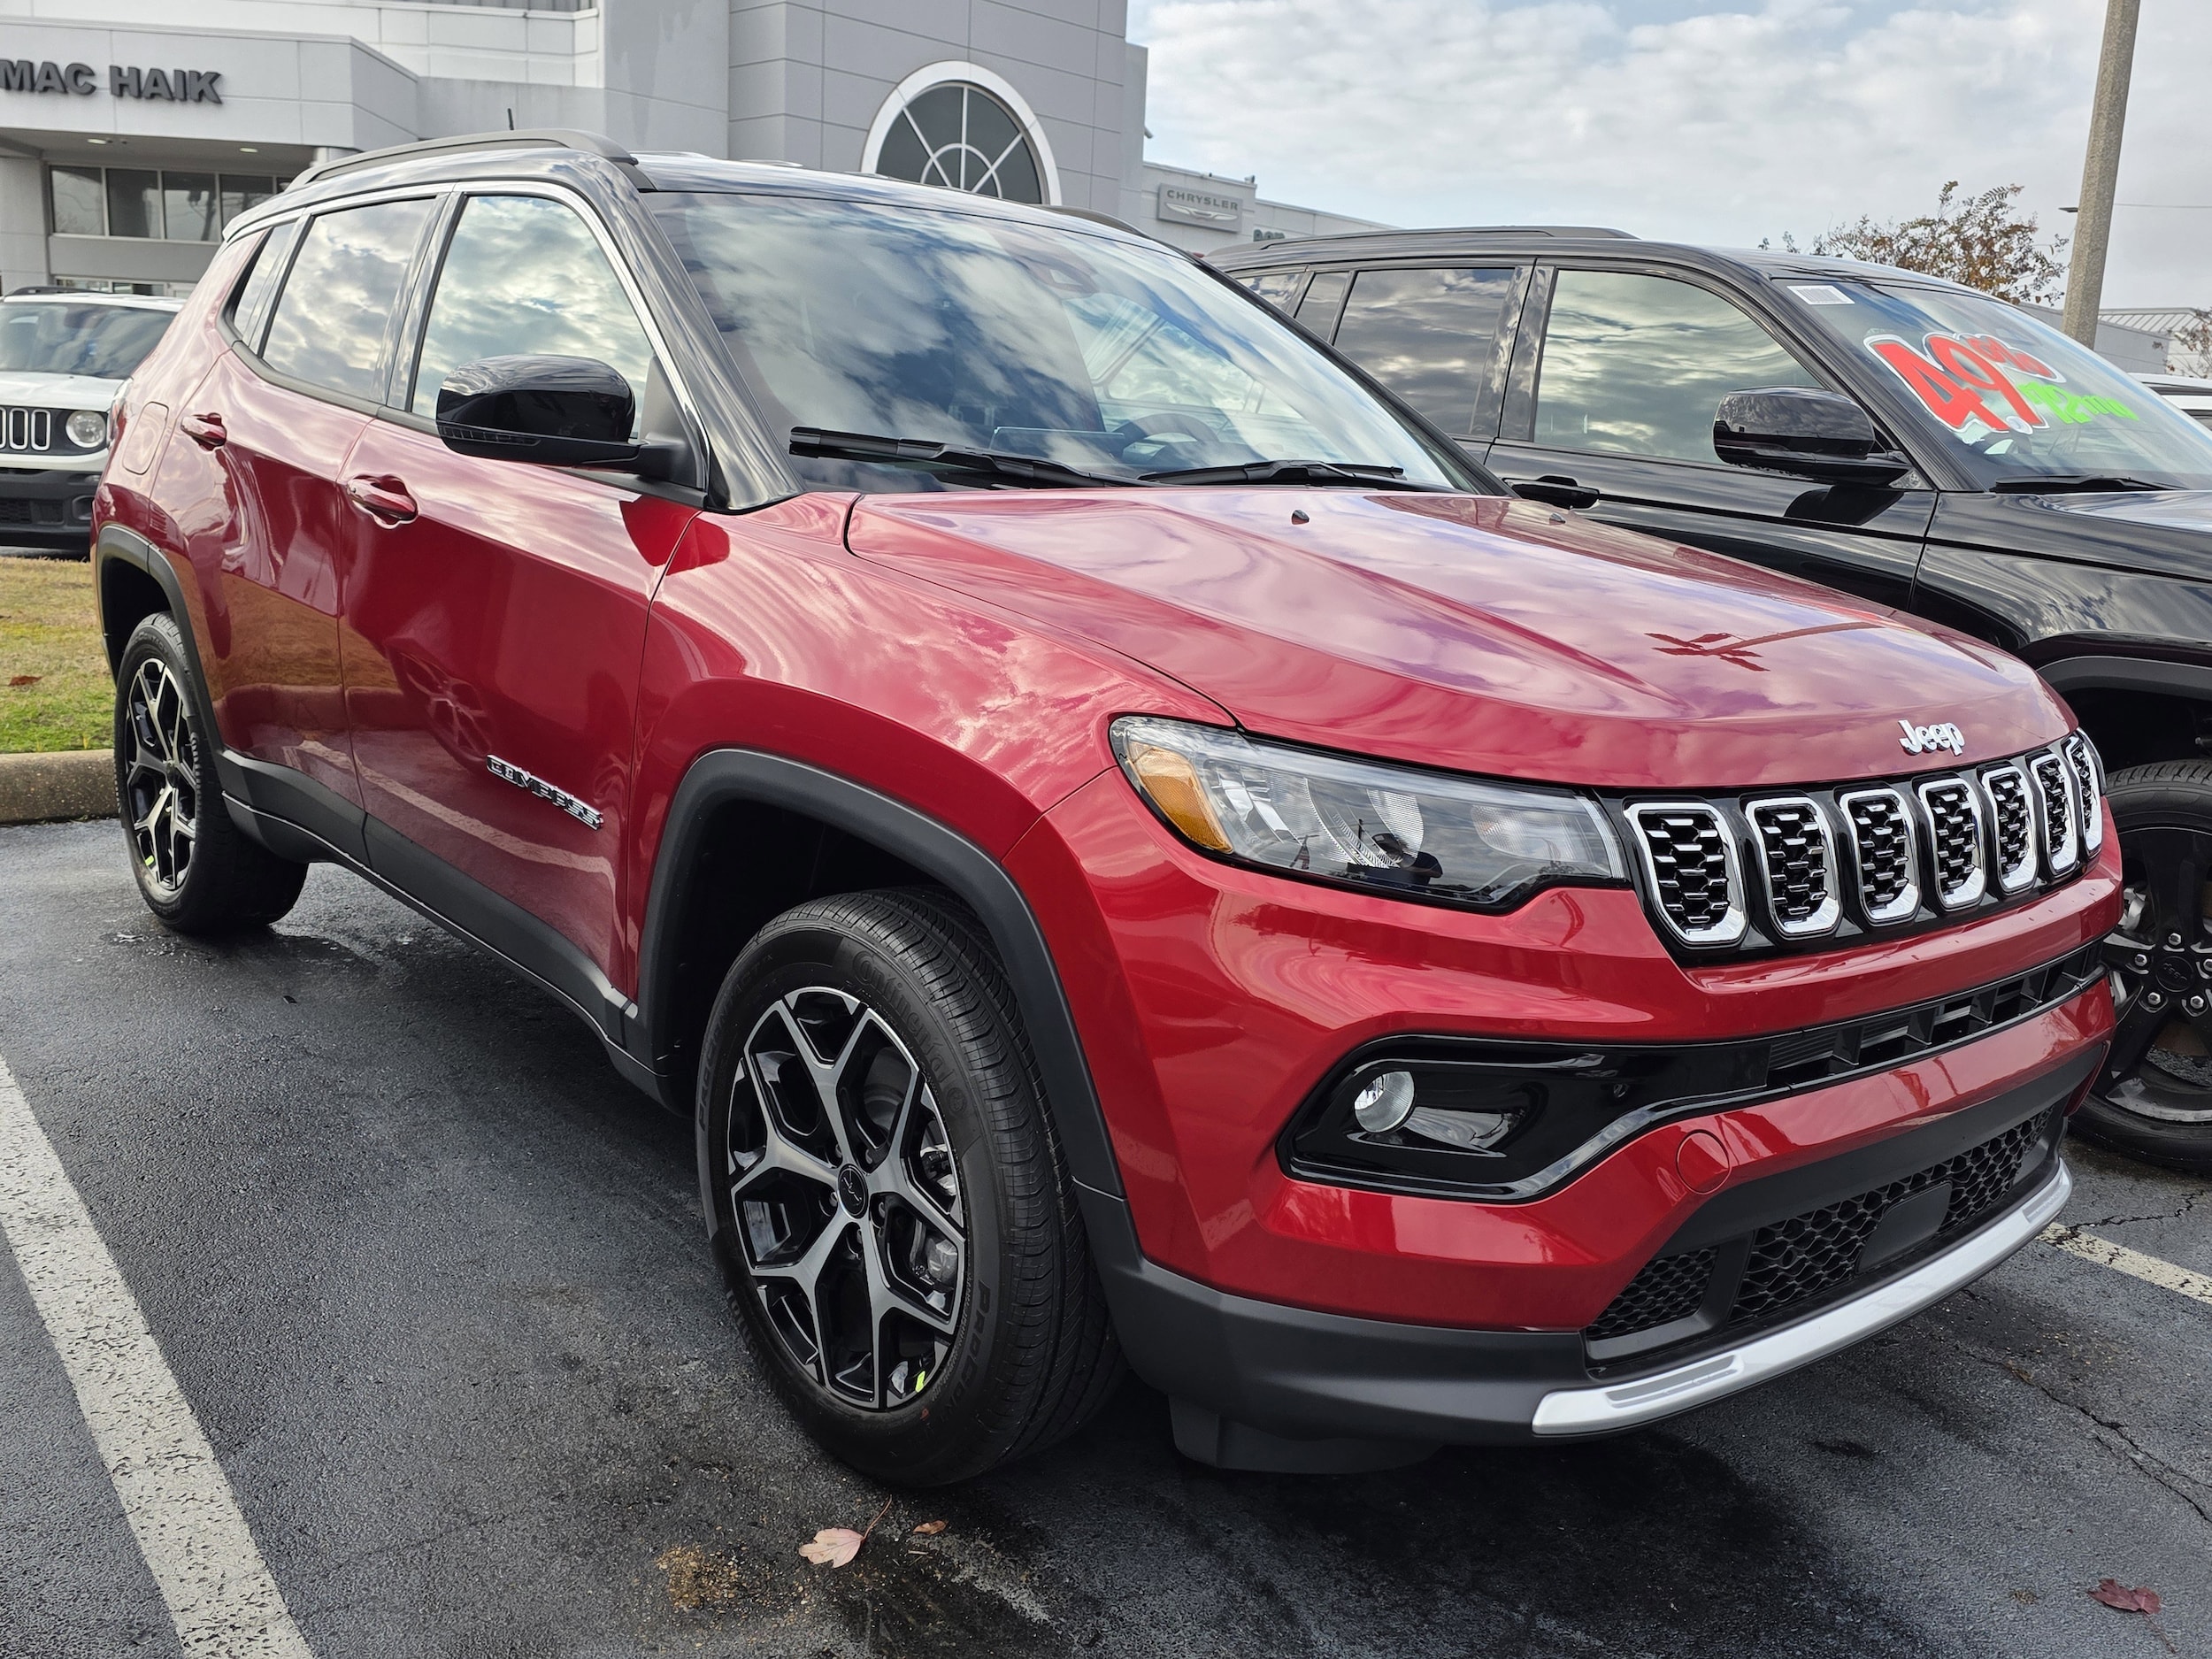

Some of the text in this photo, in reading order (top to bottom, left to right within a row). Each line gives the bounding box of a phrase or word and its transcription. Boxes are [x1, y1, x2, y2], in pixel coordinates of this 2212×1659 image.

[0, 58, 223, 104] MAC HAIK
[1166, 188, 1238, 211] CHRYSLER
[1898, 719, 1965, 757] Jeep
[486, 754, 604, 831] COMPASS
